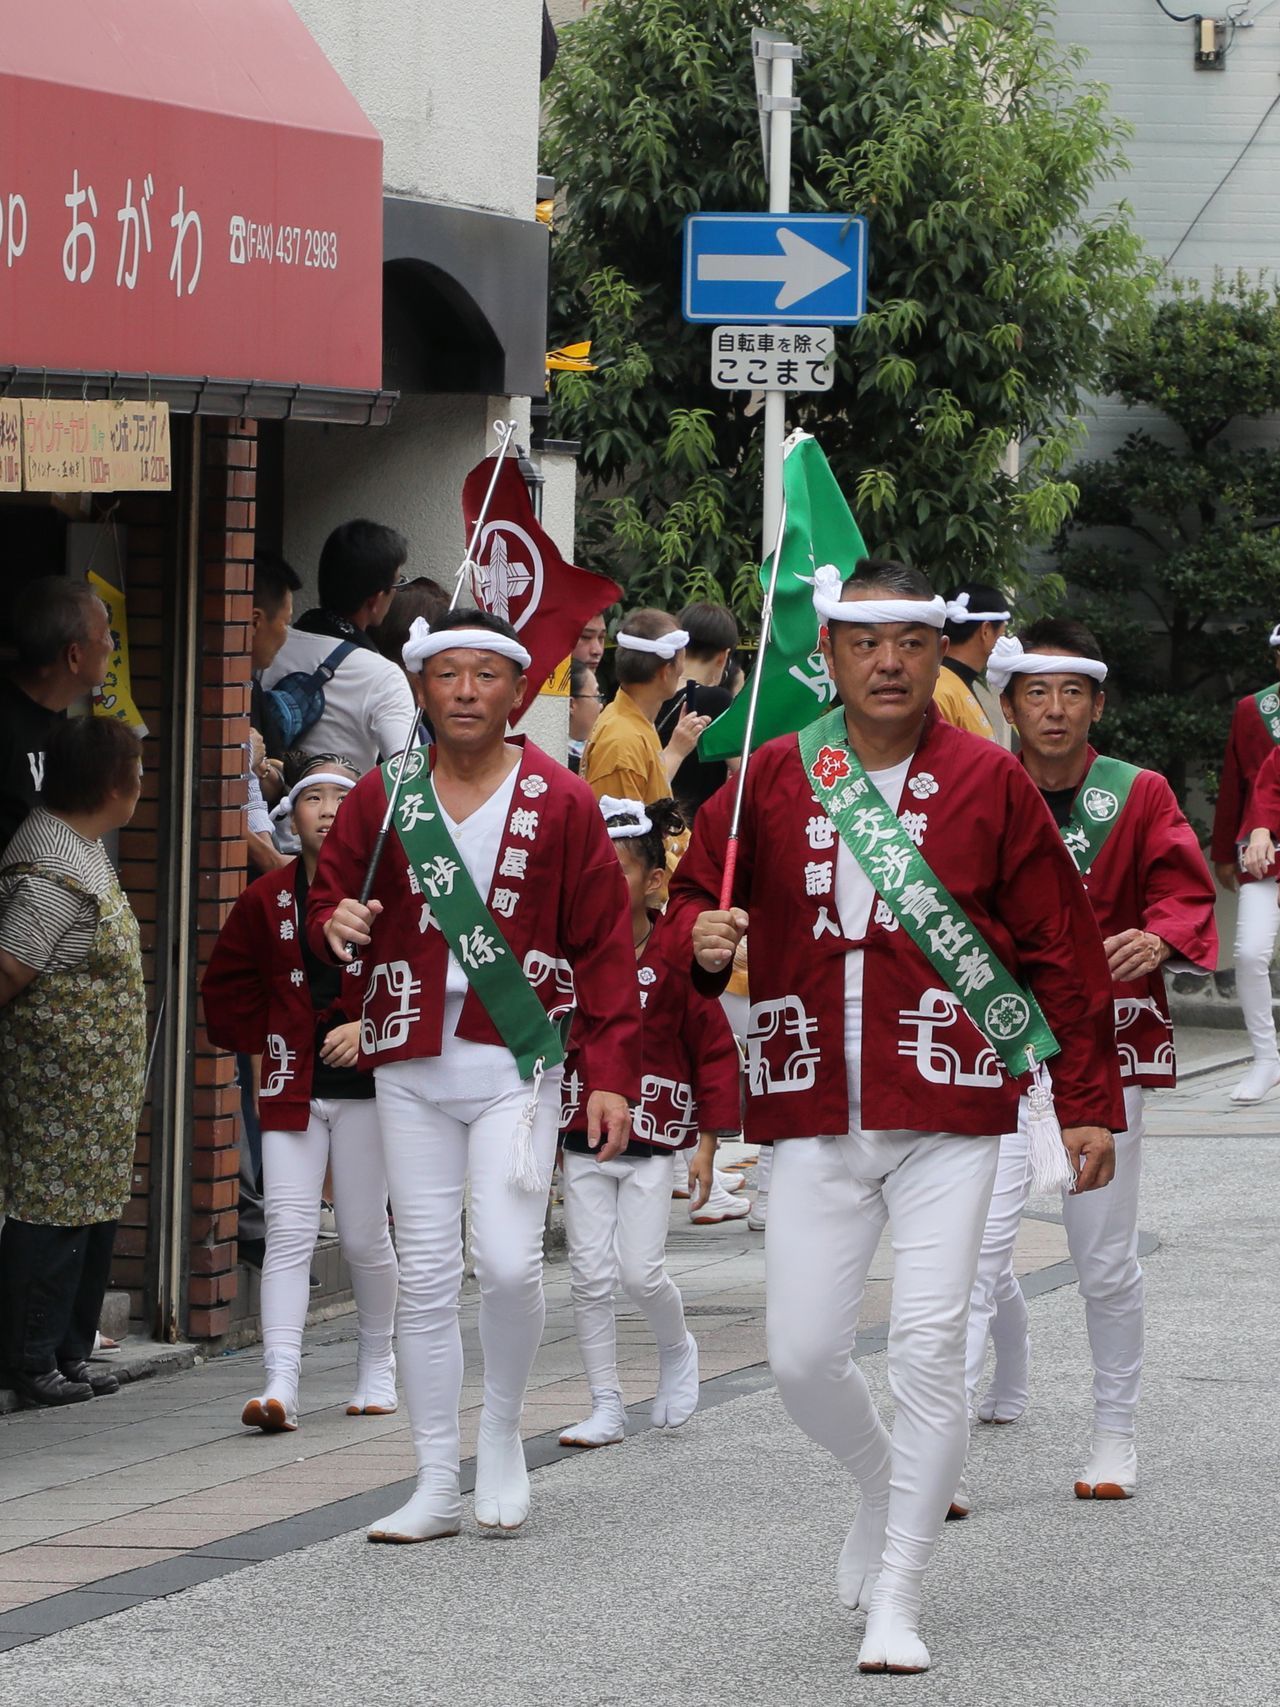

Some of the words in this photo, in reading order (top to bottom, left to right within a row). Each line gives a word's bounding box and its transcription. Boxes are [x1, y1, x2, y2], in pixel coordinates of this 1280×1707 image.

[63, 168, 202, 298] おがわ
[247, 219, 274, 263] (FAX)
[276, 225, 301, 265] 437
[304, 229, 338, 270] 2983
[716, 359, 829, 386] ここまで
[718, 333, 828, 354] 自転車を除く
[827, 777, 870, 817] 紙屋町
[398, 793, 506, 969] 交渉係
[491, 806, 539, 919] 紙屋町
[804, 815, 842, 941] 世話人
[851, 807, 996, 998] 交渉責任者
